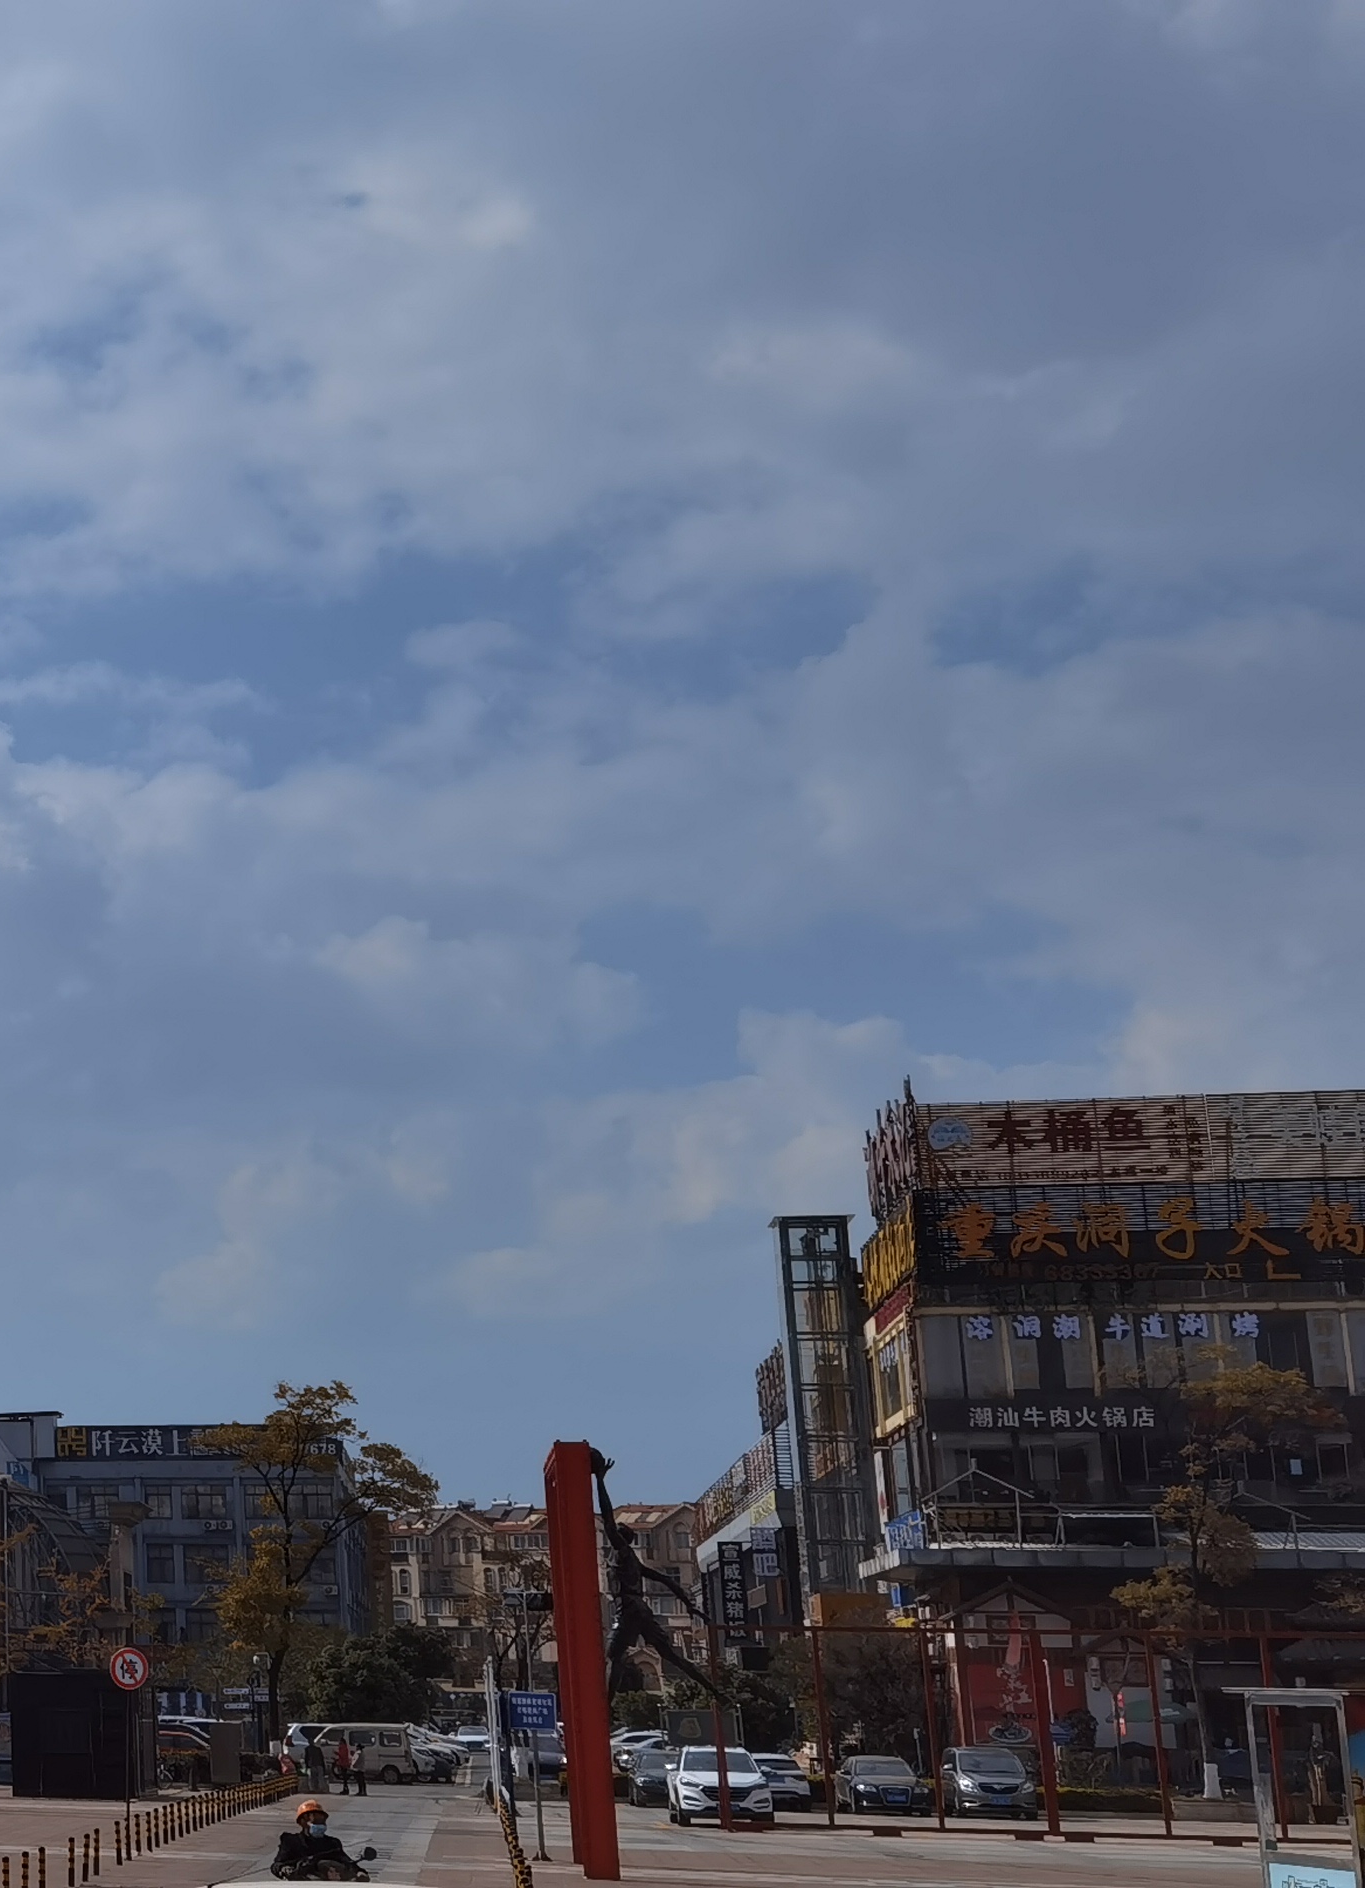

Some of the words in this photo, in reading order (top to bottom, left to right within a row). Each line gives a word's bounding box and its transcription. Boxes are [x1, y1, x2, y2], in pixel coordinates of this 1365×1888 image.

[987, 1109, 1151, 1153] 木桶鱼
[968, 1406, 1156, 1430] 潮汕牛肉火锅店
[91, 1430, 187, 1457] 阡云漠上
